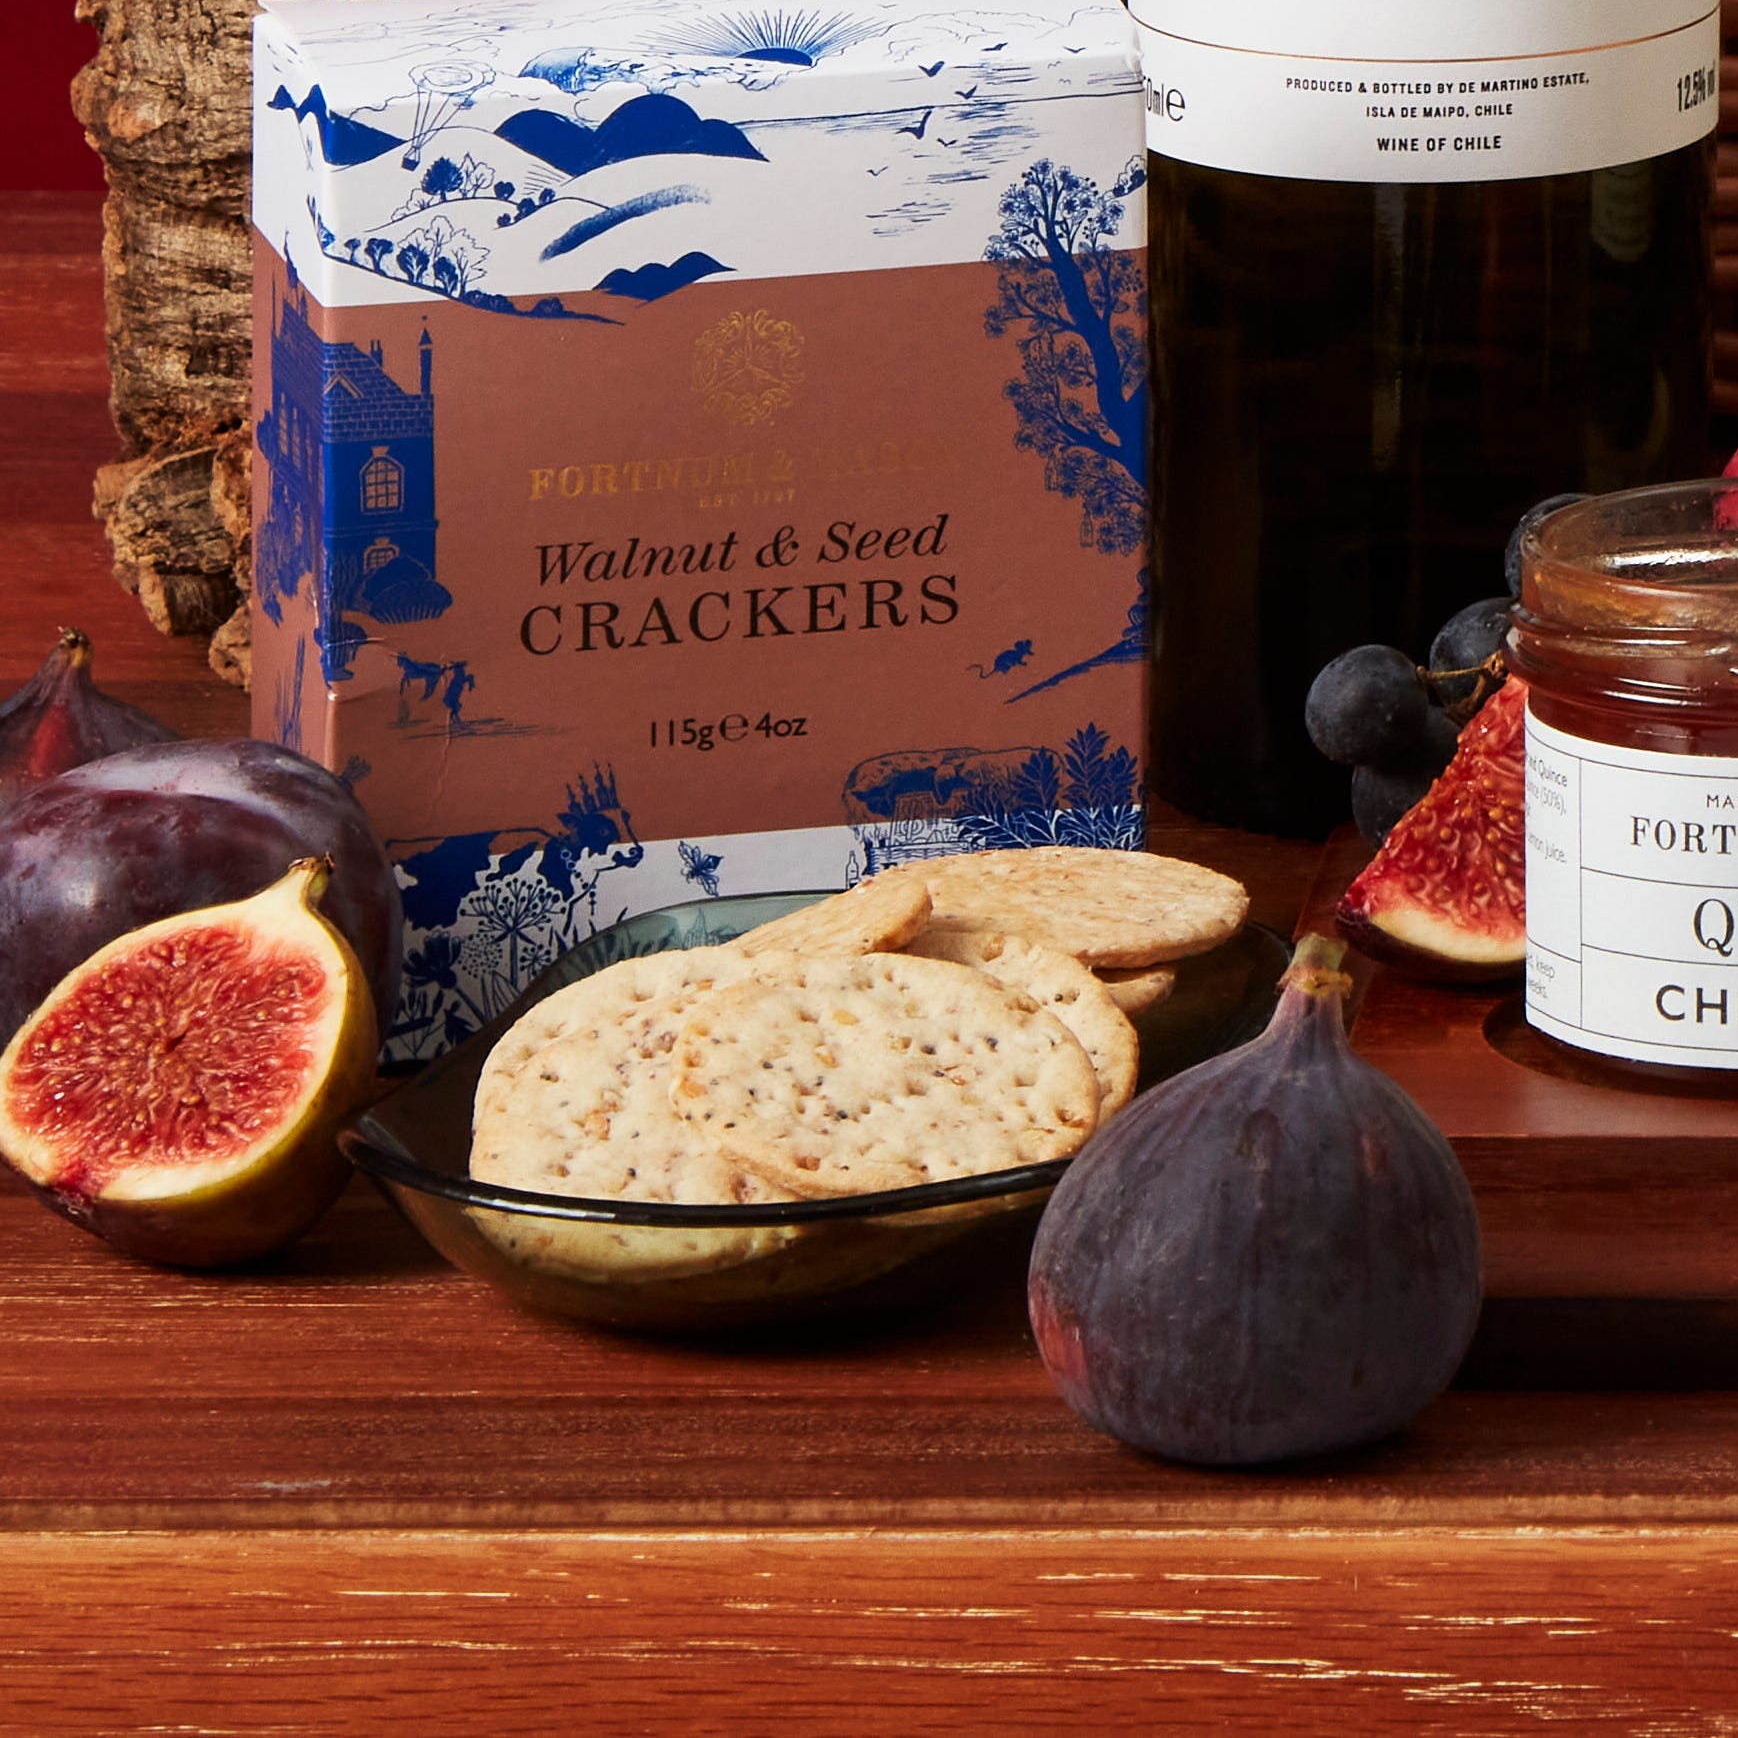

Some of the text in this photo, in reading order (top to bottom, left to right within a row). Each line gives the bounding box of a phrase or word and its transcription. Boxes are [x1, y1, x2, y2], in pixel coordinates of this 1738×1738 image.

[1286, 72, 1589, 95] PRODUCED & BOTTLED BY DE MARTINO ESTATE,
[1366, 102, 1512, 119] ISLA DE MAIPO, CHILE
[1377, 134, 1502, 152] WINE OF CHILE
[536, 515, 949, 586] Walnut & Seed
[521, 575, 960, 655] CRACKERS
[755, 713, 807, 738] 4oz
[1538, 759, 1568, 788] Quince
